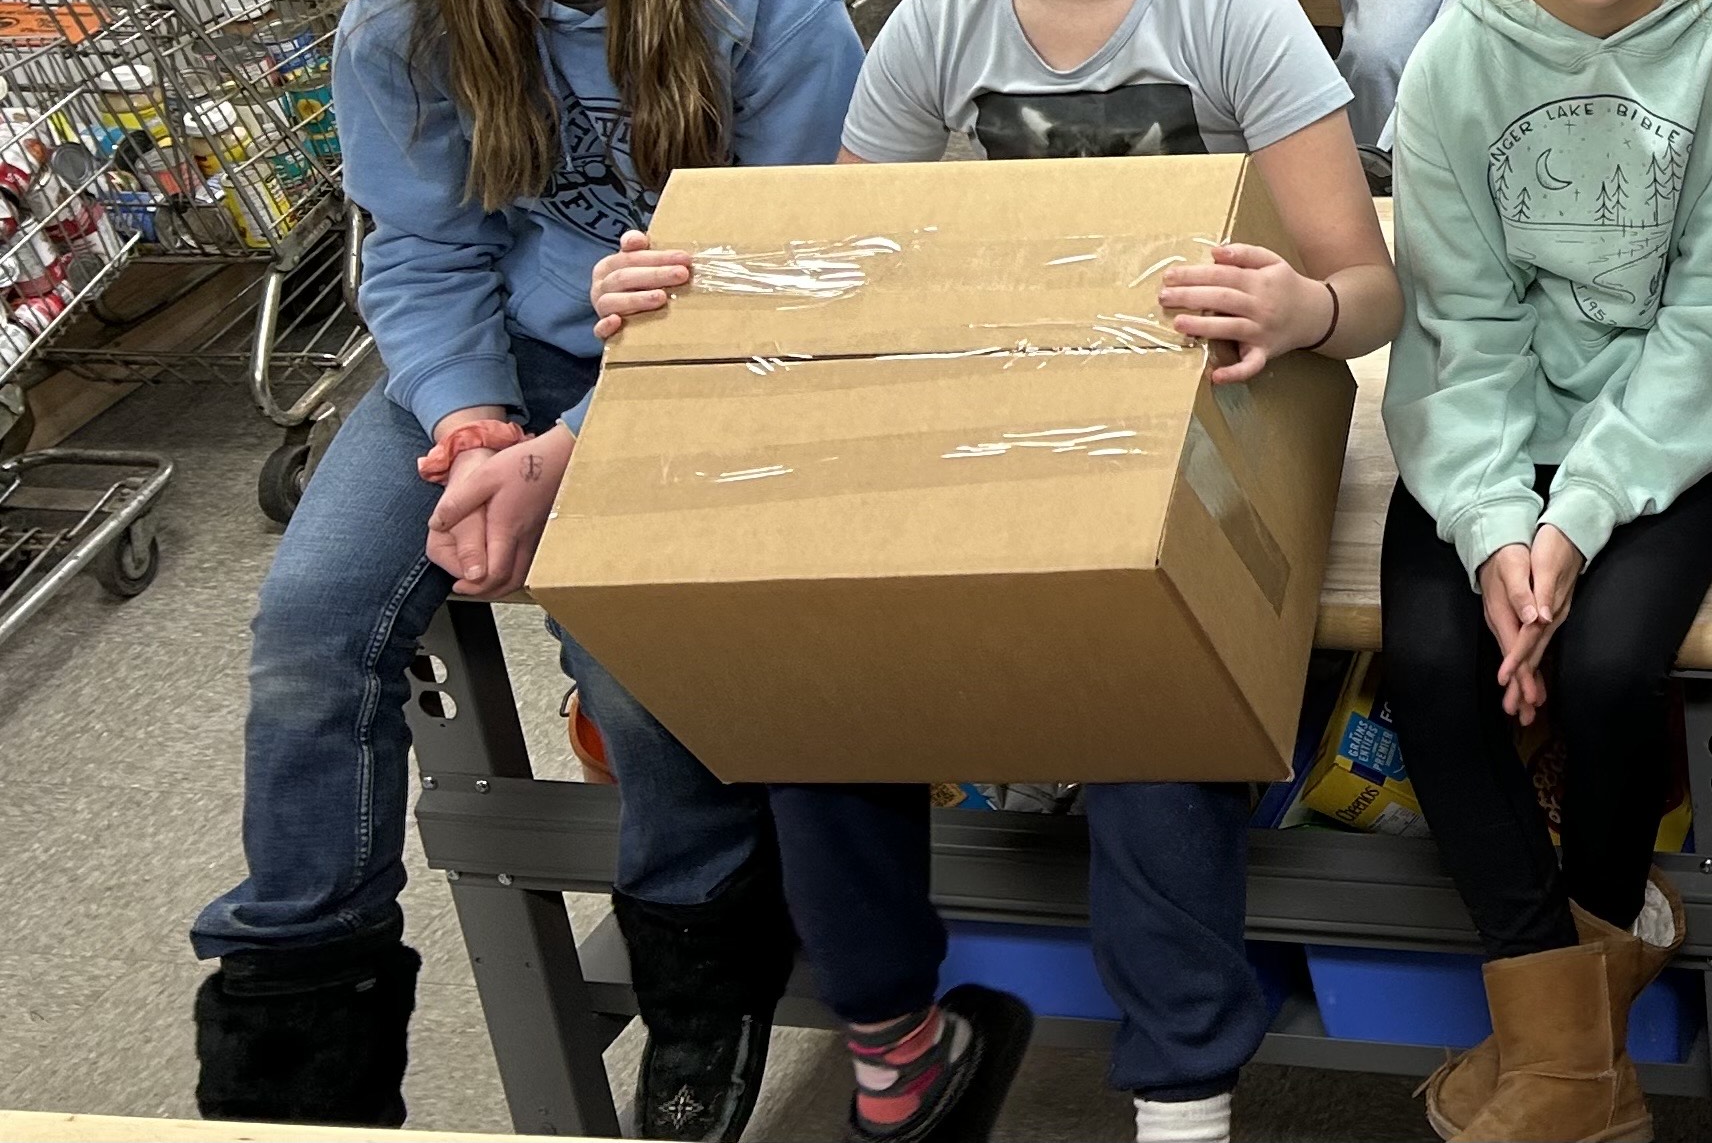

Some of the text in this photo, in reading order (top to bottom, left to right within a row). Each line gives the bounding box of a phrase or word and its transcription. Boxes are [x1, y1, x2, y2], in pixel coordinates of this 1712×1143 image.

[1546, 102, 1595, 120] LAKE
[1616, 103, 1681, 143] BIBLE
[1348, 720, 1369, 757] GRAINS
[1359, 724, 1379, 763] ENTIERS
[1372, 730, 1394, 772] PREMIER
[1336, 784, 1380, 823] Cheerios
